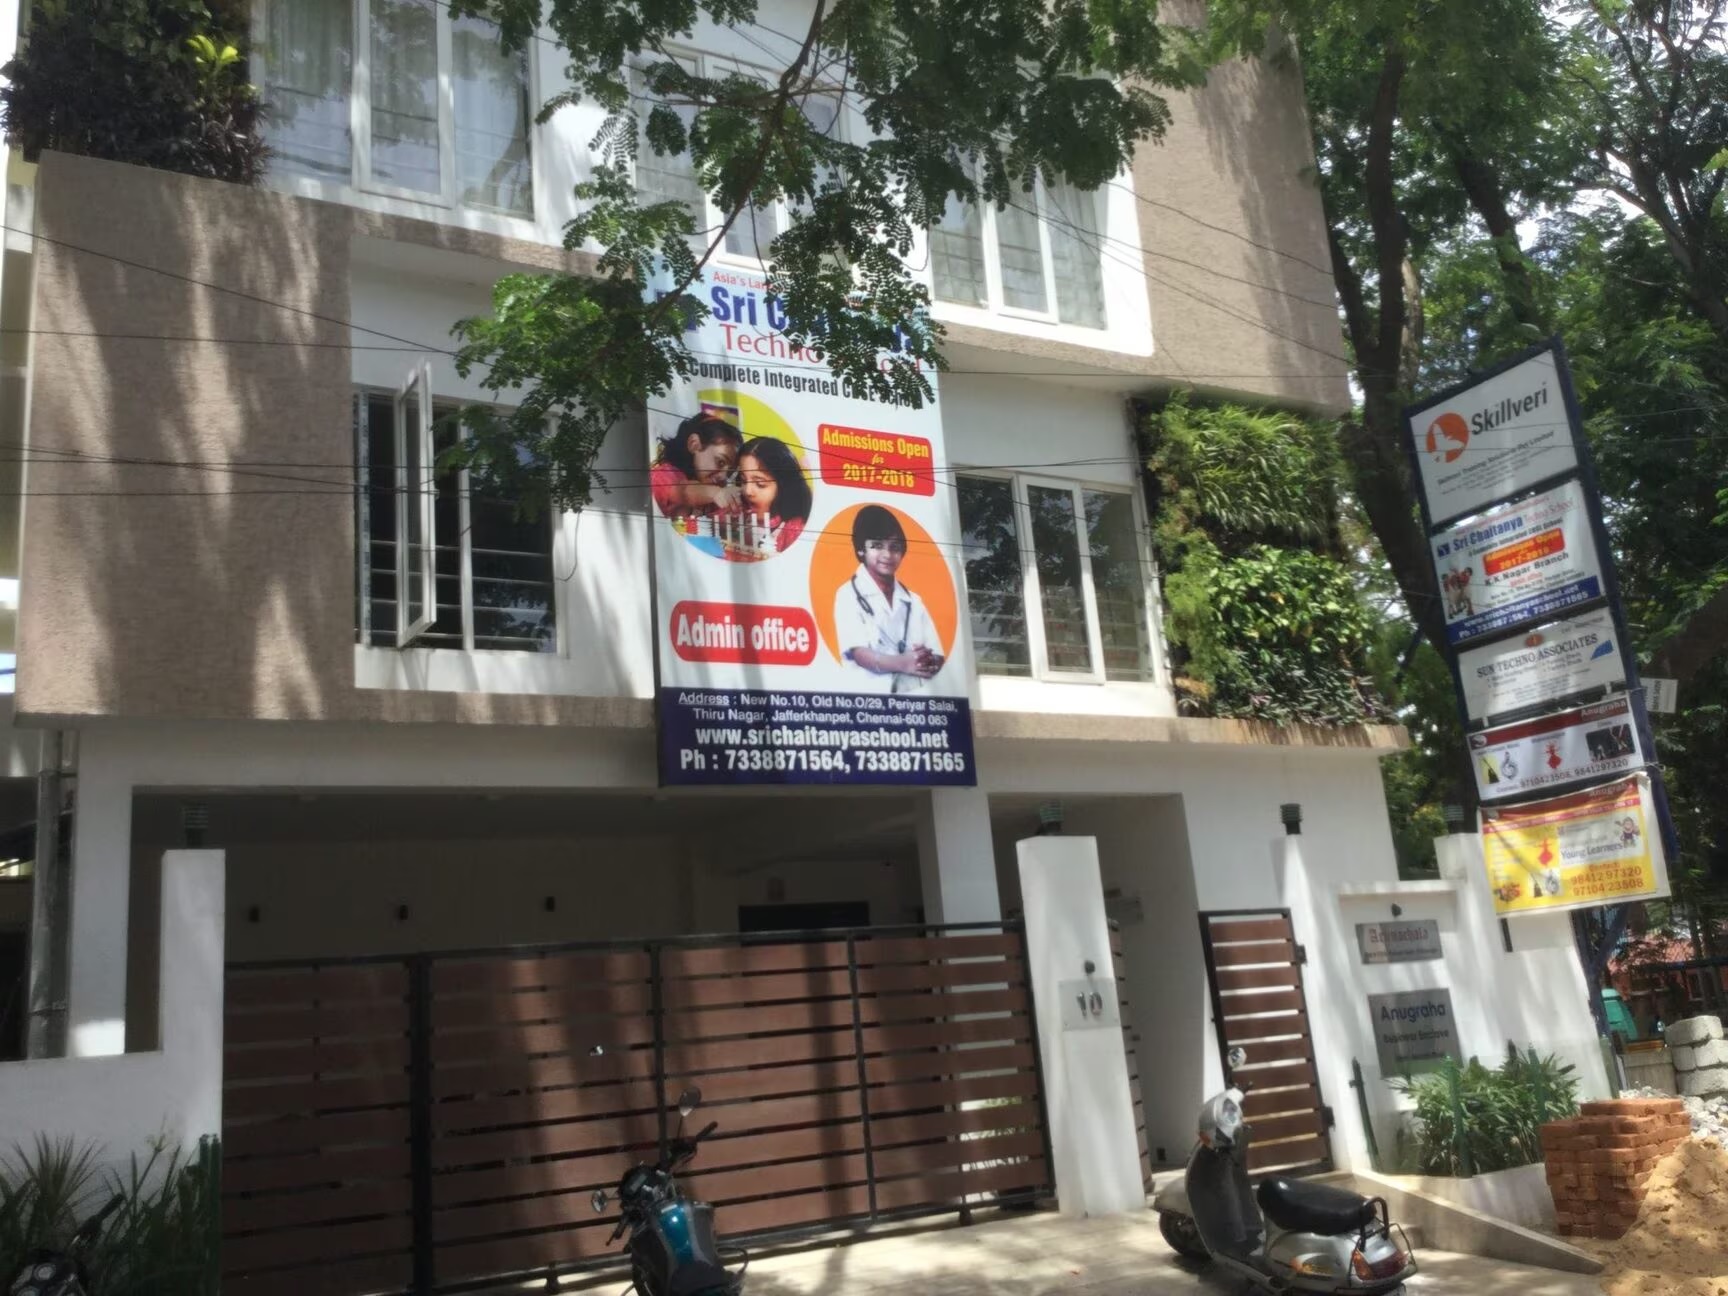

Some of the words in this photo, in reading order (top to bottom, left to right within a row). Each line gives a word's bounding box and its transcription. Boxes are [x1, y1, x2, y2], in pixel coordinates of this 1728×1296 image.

[713, 271, 746, 287] Asia's
[711, 286, 757, 326] Sri
[689, 360, 761, 384] Complete
[764, 368, 839, 396] Integrated
[1471, 380, 1548, 436] Skillveri
[823, 428, 895, 453] Admissions
[897, 438, 929, 458] Open
[872, 453, 885, 465] for
[842, 463, 915, 488] 2017-2018
[1453, 536, 1469, 551] Sri
[1535, 552, 1569, 570] Branch
[677, 613, 745, 649] Admin
[751, 618, 810, 652] office
[1497, 652, 1536, 672] TECHNO
[1537, 632, 1598, 660] ASSOCIATES
[679, 692, 730, 706] Address
[740, 693, 767, 705] New
[770, 694, 809, 707] No.10,
[812, 694, 833, 707] Old
[888, 698, 926, 712] Periyar
[693, 708, 725, 720] Thiru
[728, 709, 769, 723] Nagar,
[695, 724, 949, 750] www.srichaitanyaschool.net
[680, 748, 706, 770] Ph
[725, 749, 851, 774] 7338871564,
[854, 751, 965, 772] 7338871565
[1605, 865, 1642, 879] 97320
[1380, 1001, 1447, 1023] Anugraha
